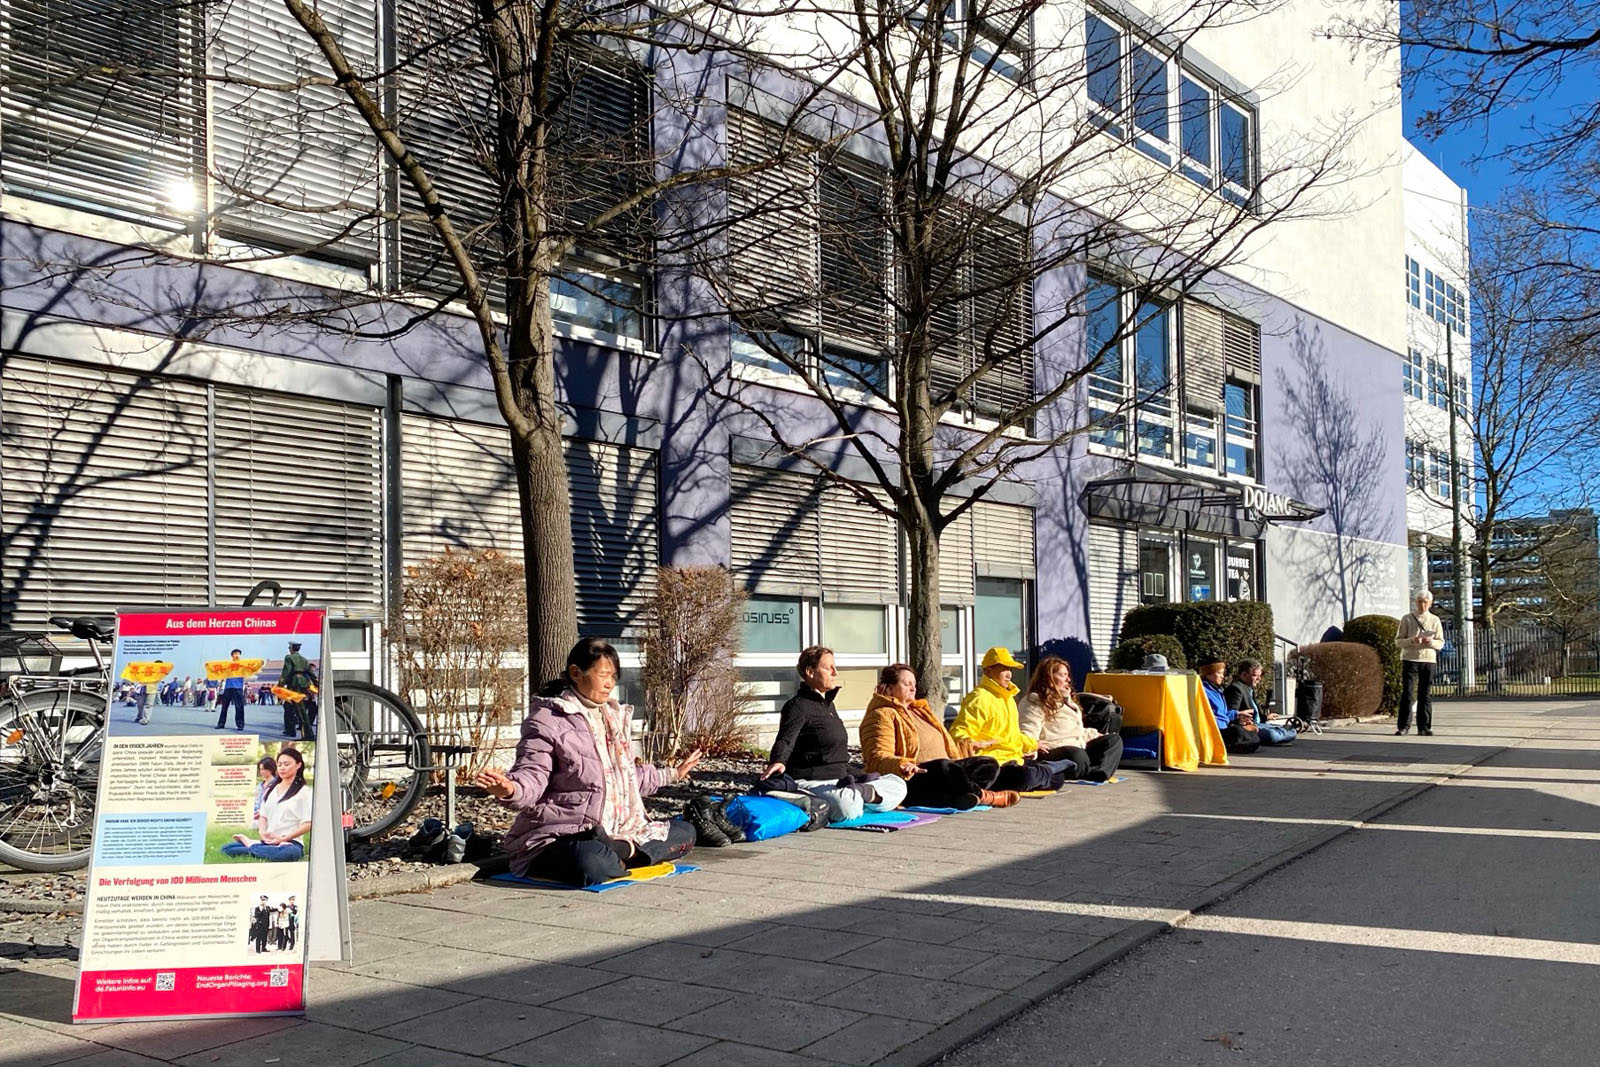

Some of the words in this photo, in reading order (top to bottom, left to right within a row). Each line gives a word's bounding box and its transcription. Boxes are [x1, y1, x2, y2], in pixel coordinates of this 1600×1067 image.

[1245, 486, 1292, 515] DOJANG
[1227, 568, 1239, 579] TEA
[166, 618, 184, 628] Aus
[186, 618, 206, 628] dem
[208, 618, 242, 628] Herzen
[244, 617, 277, 627] Chinas
[113, 877, 154, 886] Verfolgung
